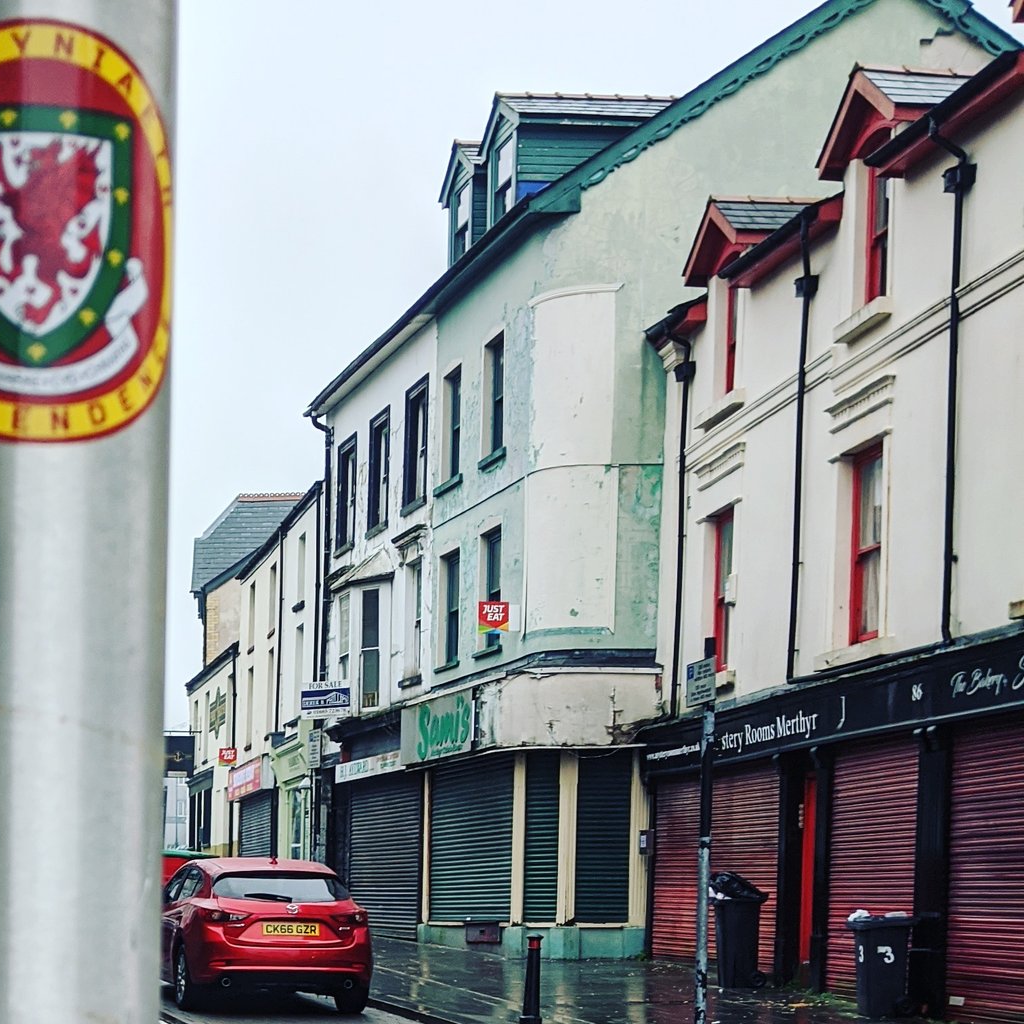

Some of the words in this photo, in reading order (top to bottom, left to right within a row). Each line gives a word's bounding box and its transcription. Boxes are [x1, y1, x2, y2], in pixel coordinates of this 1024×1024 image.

[482, 604, 506, 614] JUST
[487, 613, 505, 622] EAT
[308, 682, 323, 690] FOR
[324, 680, 342, 689] SALE
[744, 723, 776, 746] Rooms
[775, 709, 820, 739] Merthyr
[265, 924, 294, 934] CK66
[296, 924, 317, 934] GZR
